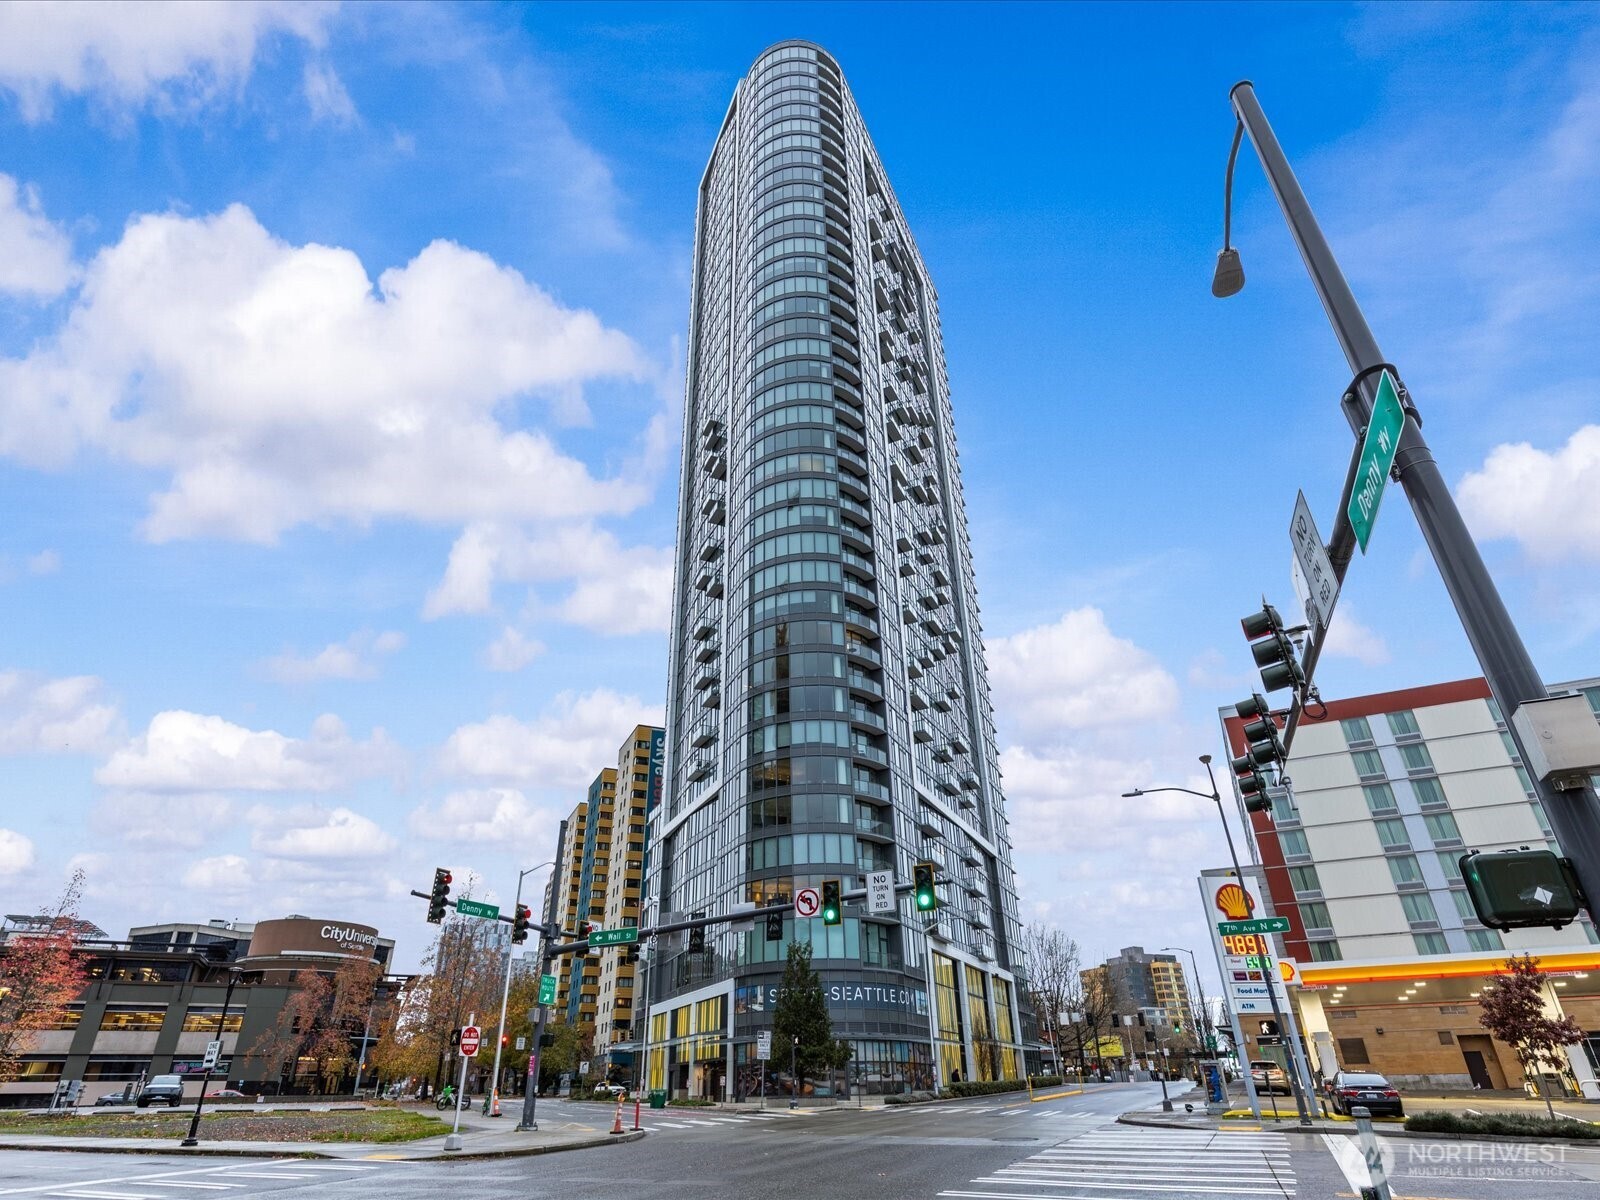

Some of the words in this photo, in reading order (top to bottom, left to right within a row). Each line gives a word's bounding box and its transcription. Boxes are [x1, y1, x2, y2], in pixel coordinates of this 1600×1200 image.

[1357, 453, 1383, 521] Denny
[1377, 426, 1391, 454] Wy
[1296, 515, 1307, 547] NO
[1304, 533, 1316, 567] TURN
[1313, 560, 1322, 583] ON
[1319, 578, 1331, 606] RED
[873, 875, 886, 884] NO
[876, 893, 886, 901] ON
[461, 902, 483, 915] Denny
[875, 901, 888, 909] RED
[1223, 924, 1238, 933] 7th
[1259, 922, 1268, 931] N
[607, 932, 621, 941] Wall
